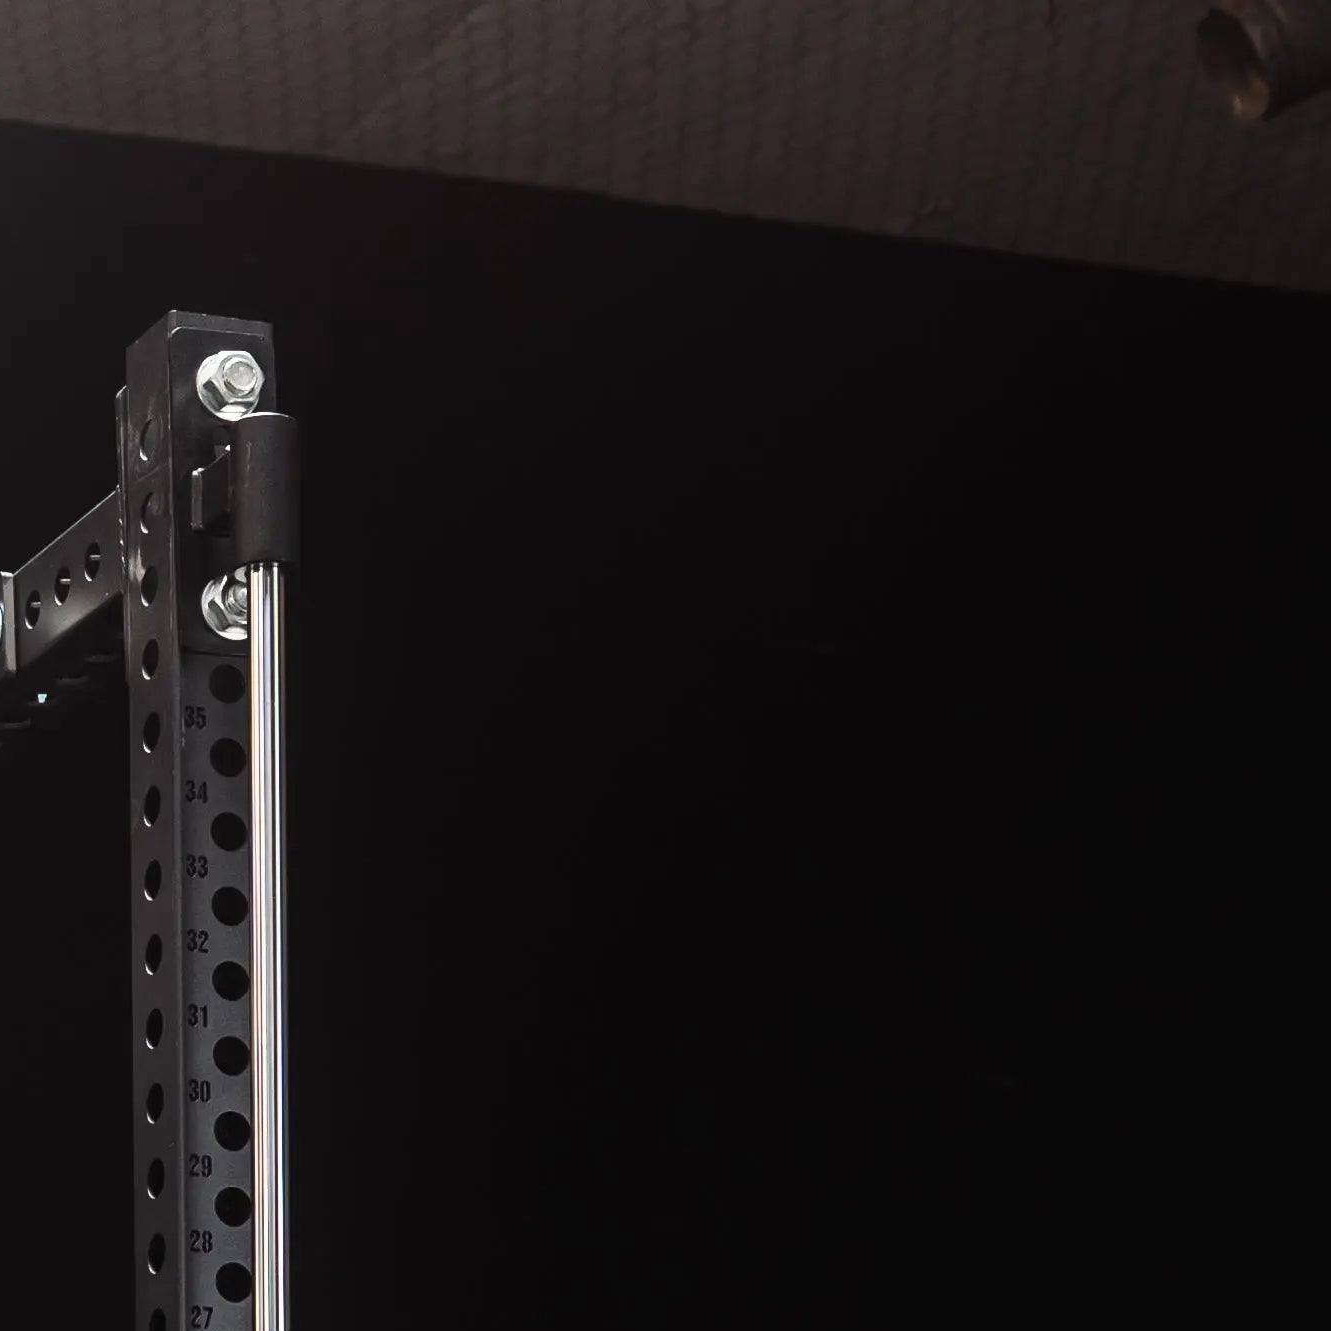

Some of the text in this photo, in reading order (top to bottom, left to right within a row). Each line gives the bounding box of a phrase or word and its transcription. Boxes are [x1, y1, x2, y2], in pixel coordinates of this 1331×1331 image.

[185, 707, 206, 728] 35
[185, 781, 207, 802] 34
[186, 856, 208, 878] 33
[187, 930, 209, 953] 32
[188, 1005, 209, 1027] 31
[188, 1080, 211, 1102] 30
[190, 1155, 212, 1177] 29
[190, 1231, 213, 1252] 28
[191, 1307, 214, 1329] 27
